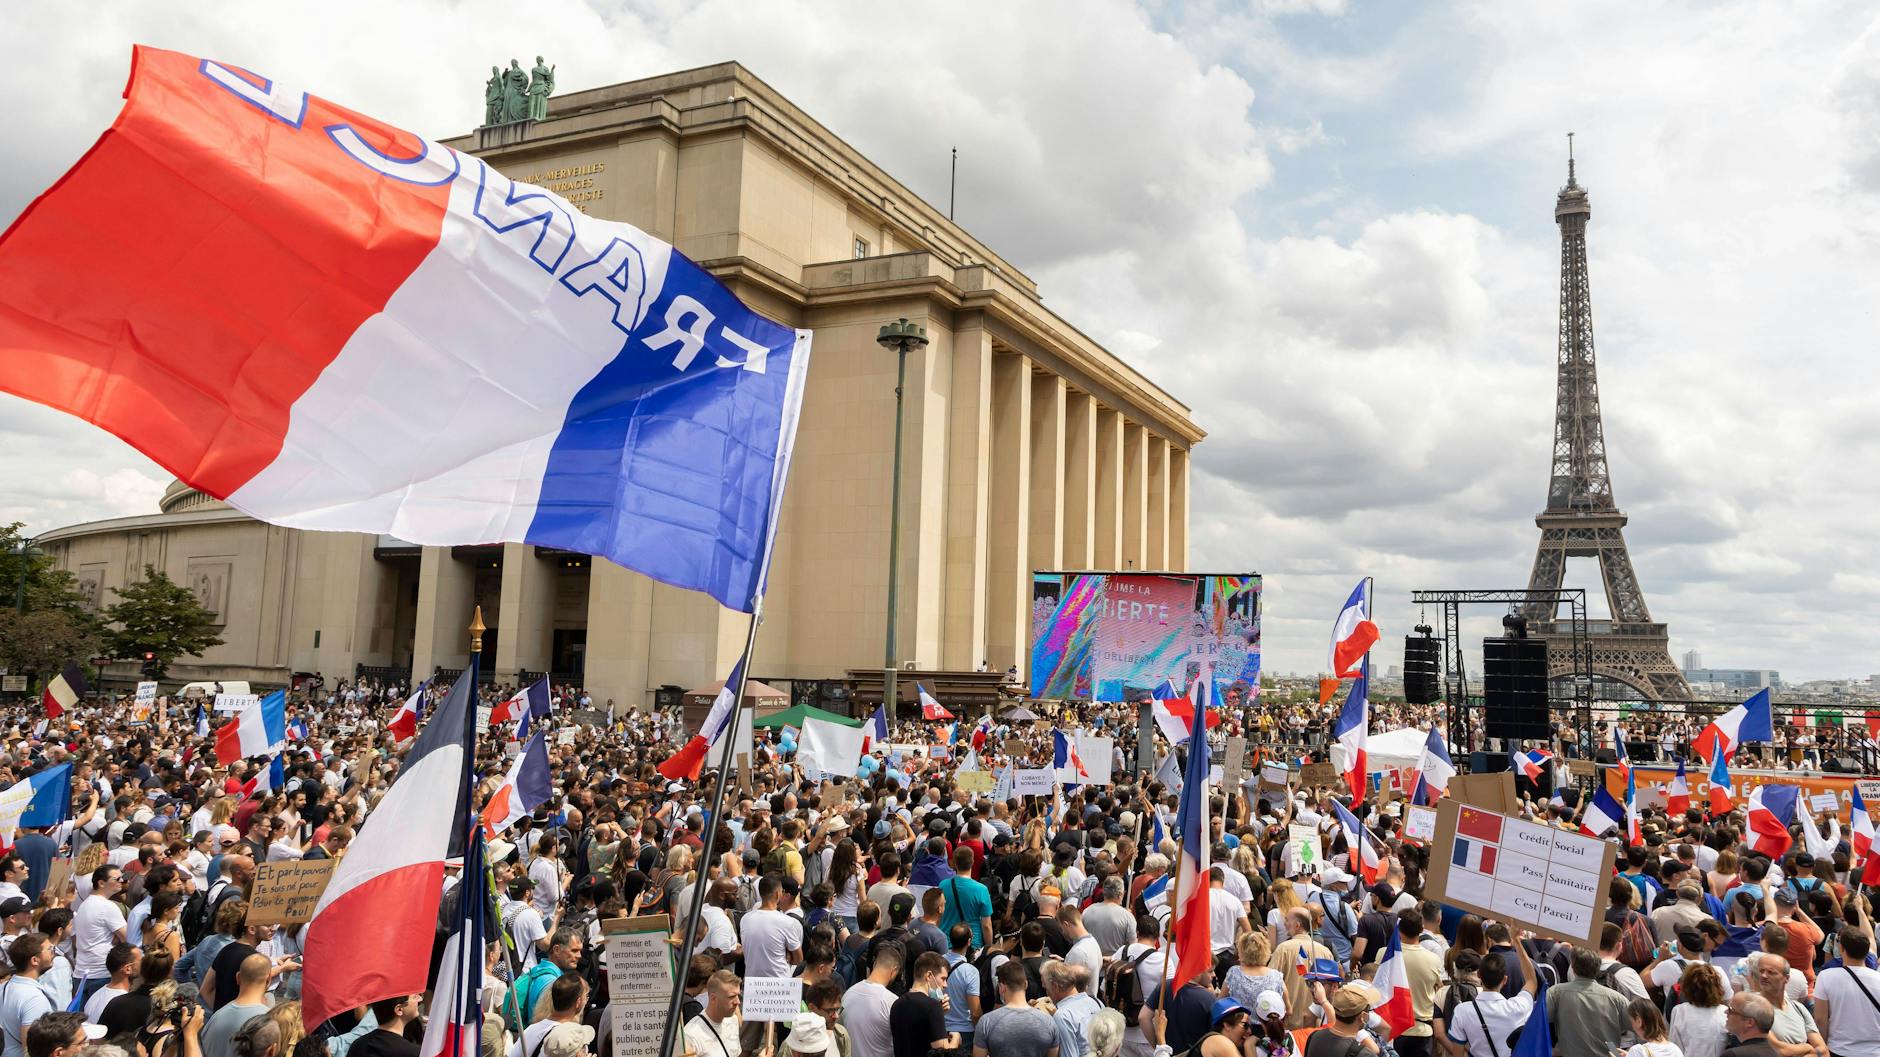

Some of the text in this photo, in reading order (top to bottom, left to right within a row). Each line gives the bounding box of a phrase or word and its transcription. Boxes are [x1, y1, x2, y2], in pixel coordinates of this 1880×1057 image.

[547, 161, 605, 181] MERVEILLES
[546, 178, 593, 193] UVRAGES
[694, 696, 711, 705] Palais
[1519, 831, 1585, 856] Crédit Social
[257, 865, 274, 880] Et
[1522, 865, 1595, 893] Pass Sanitaire
[1514, 897, 1538, 911] C'est
[1543, 905, 1573, 921] Pareil
[620, 939, 652, 948] mentir et
[612, 950, 664, 959] terroriser pour
[611, 972, 626, 981] puis
[629, 971, 658, 980] réprimer
[620, 982, 652, 991] enfermer
[636, 1009, 656, 1018] n'est
[658, 1010, 669, 1019] pa
[622, 1021, 632, 1031] de
[634, 1021, 641, 1031] la
[615, 1035, 653, 1045] publique,
[621, 1046, 661, 1056] autre cho
